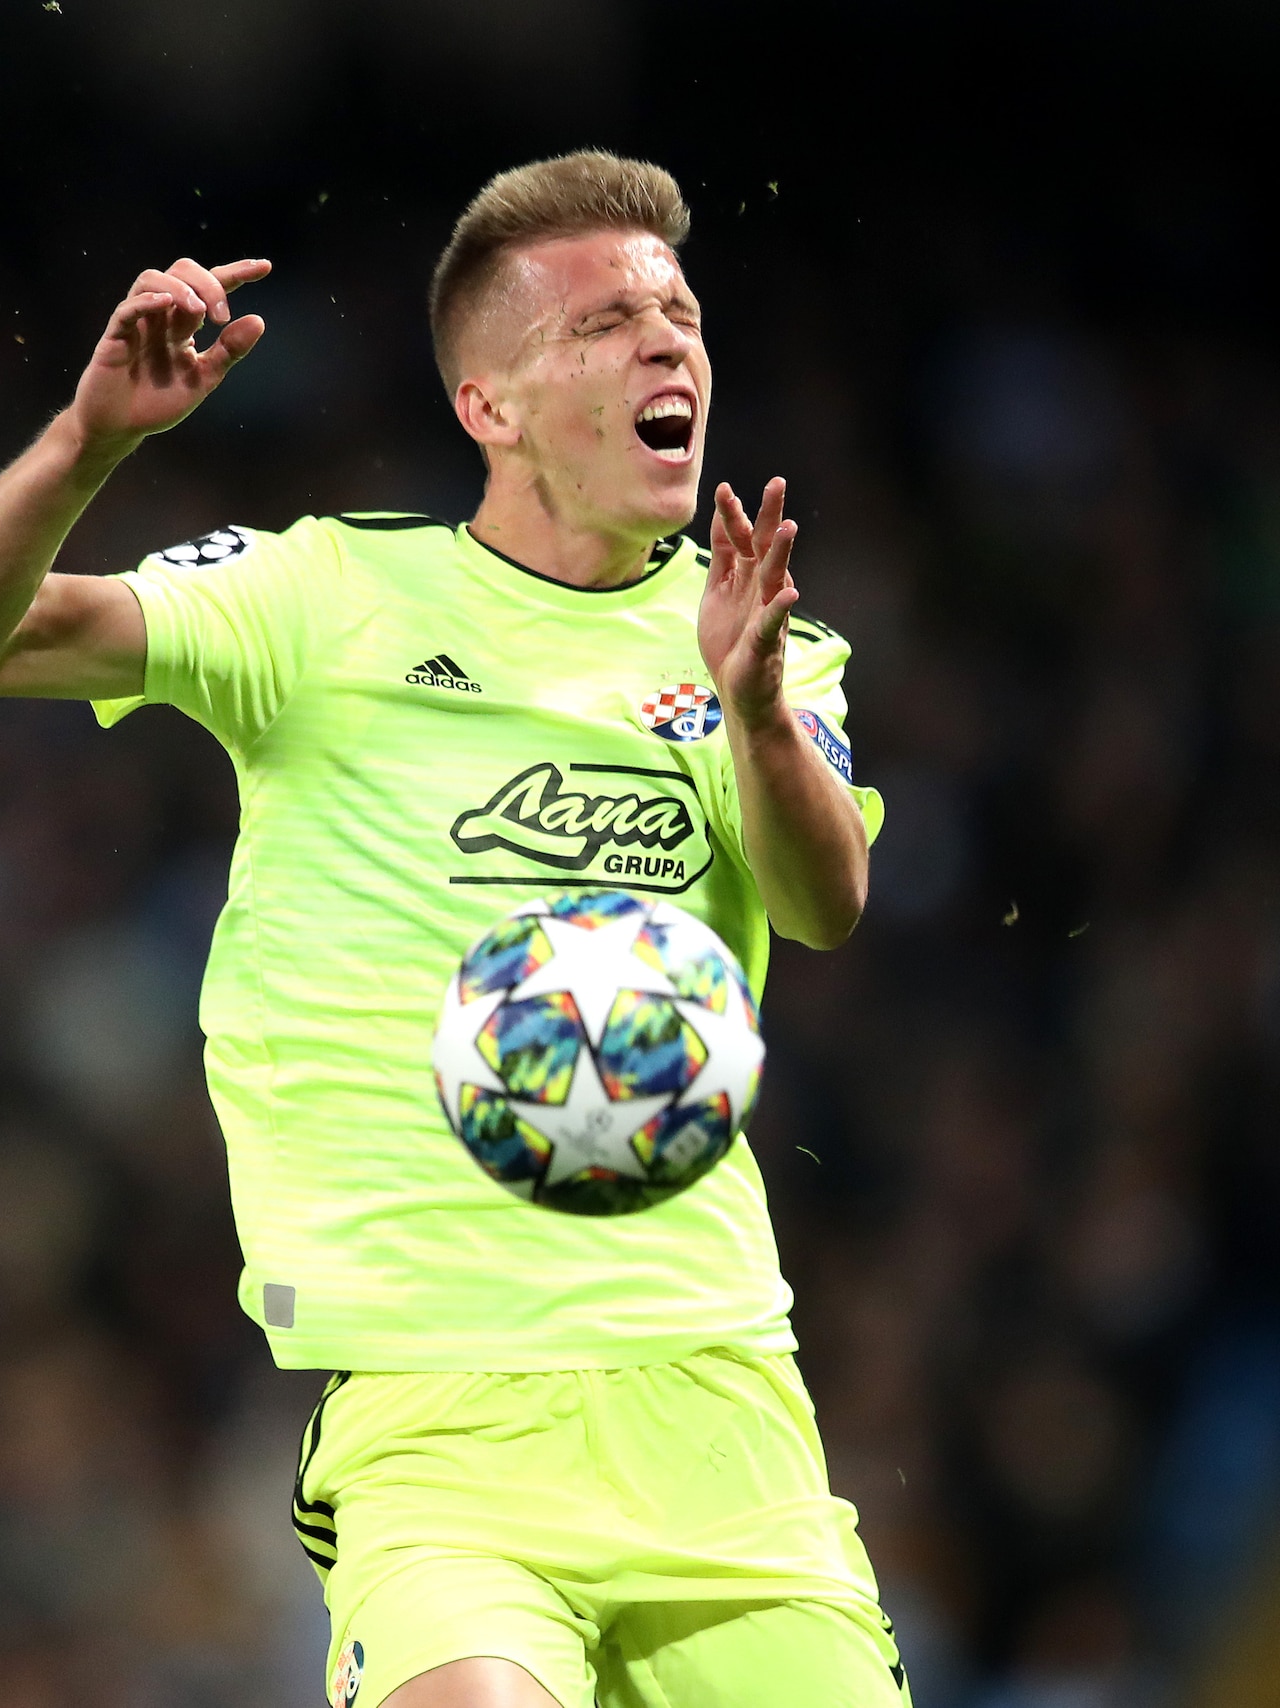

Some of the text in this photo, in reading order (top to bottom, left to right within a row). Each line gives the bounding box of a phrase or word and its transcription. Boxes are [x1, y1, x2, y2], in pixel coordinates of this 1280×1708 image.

[405, 674, 482, 694] adidas
[451, 763, 693, 868] Lana
[604, 854, 685, 880] GRUPA
